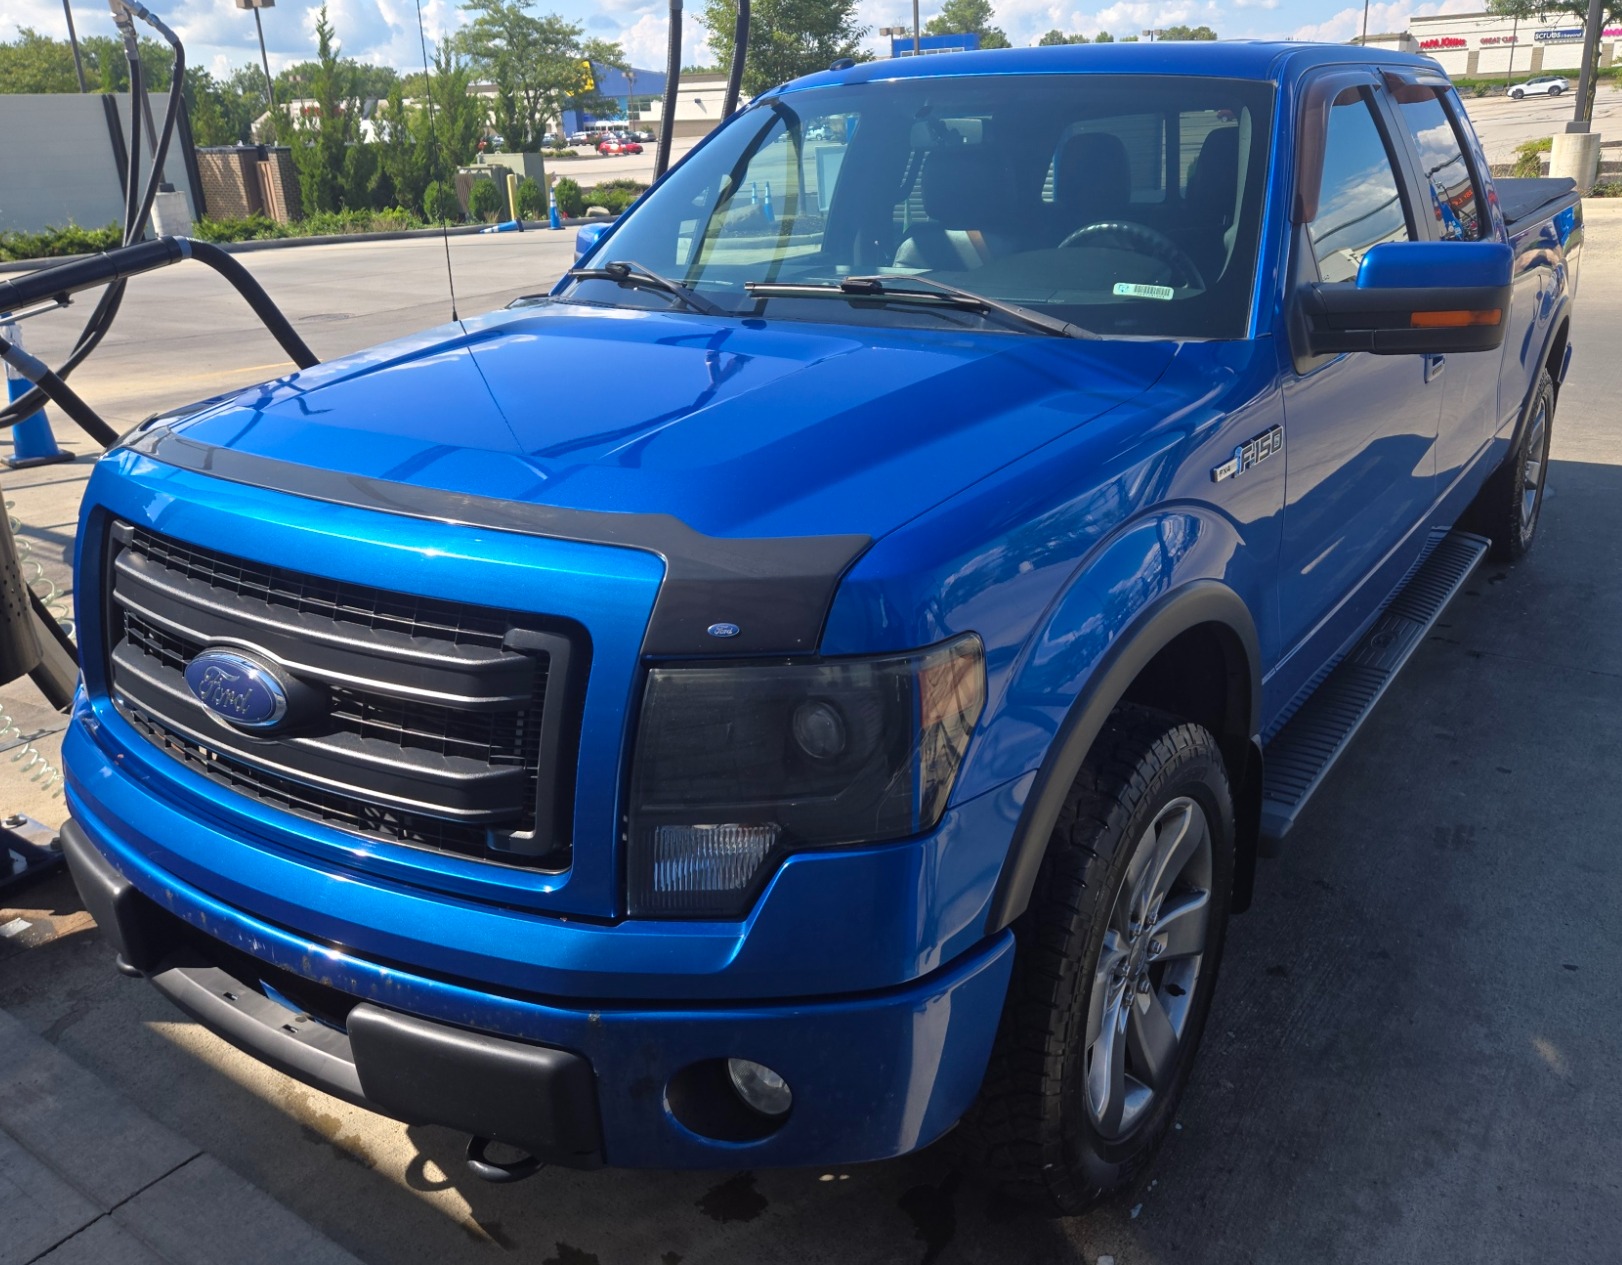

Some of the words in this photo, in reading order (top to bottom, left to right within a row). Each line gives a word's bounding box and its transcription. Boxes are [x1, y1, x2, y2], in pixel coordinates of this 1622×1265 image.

[1480, 37, 1501, 45] GREAT
[713, 623, 733, 635] Ford
[198, 665, 252, 714] Ford
